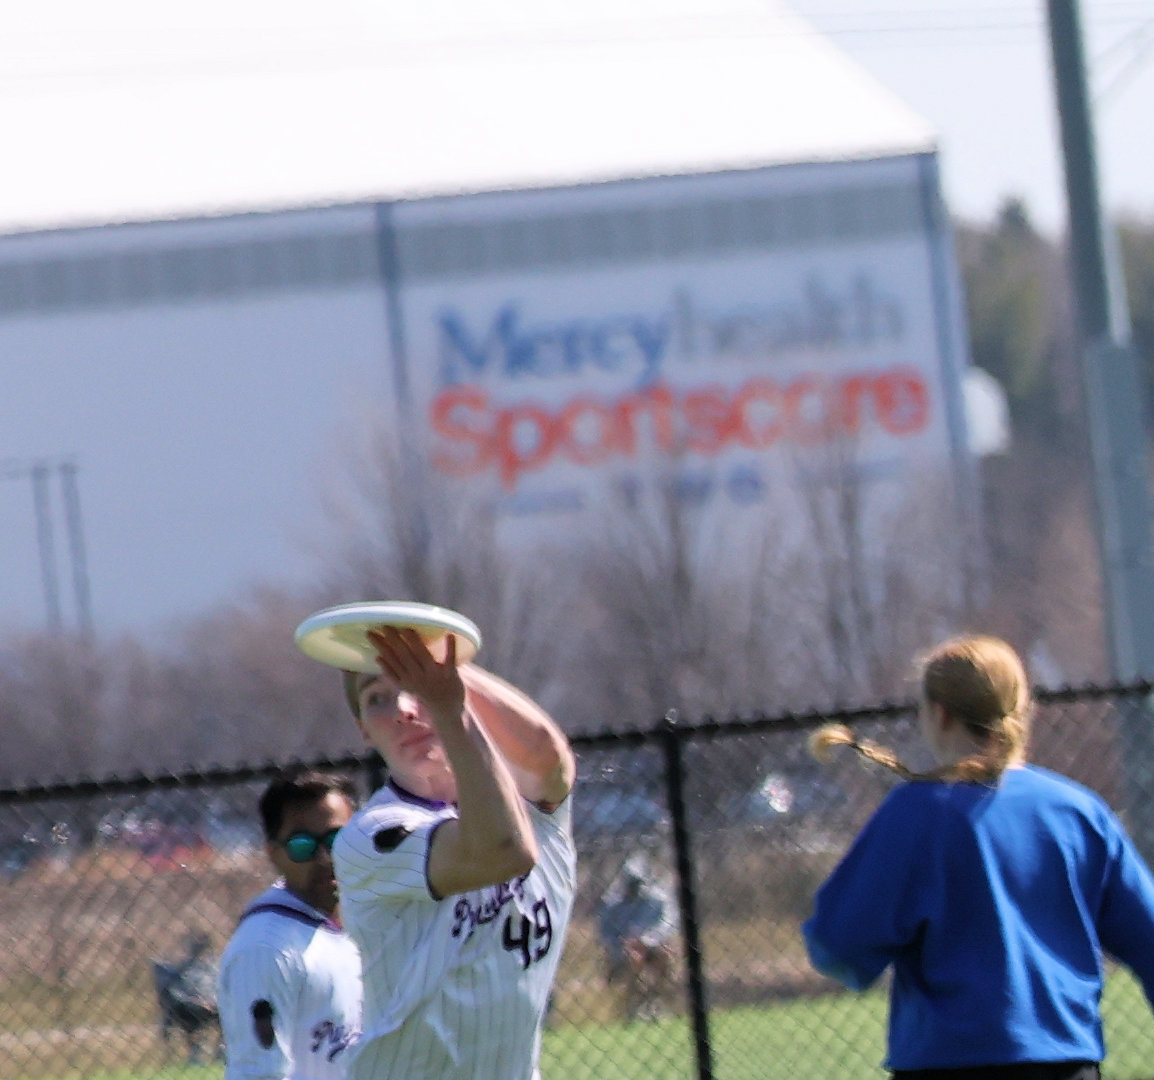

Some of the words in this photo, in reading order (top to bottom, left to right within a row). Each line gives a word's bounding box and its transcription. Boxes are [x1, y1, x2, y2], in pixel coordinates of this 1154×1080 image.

[432, 268, 906, 392] Mercyhealth
[429, 364, 929, 493] Sportscore
[502, 897, 552, 970] 49
